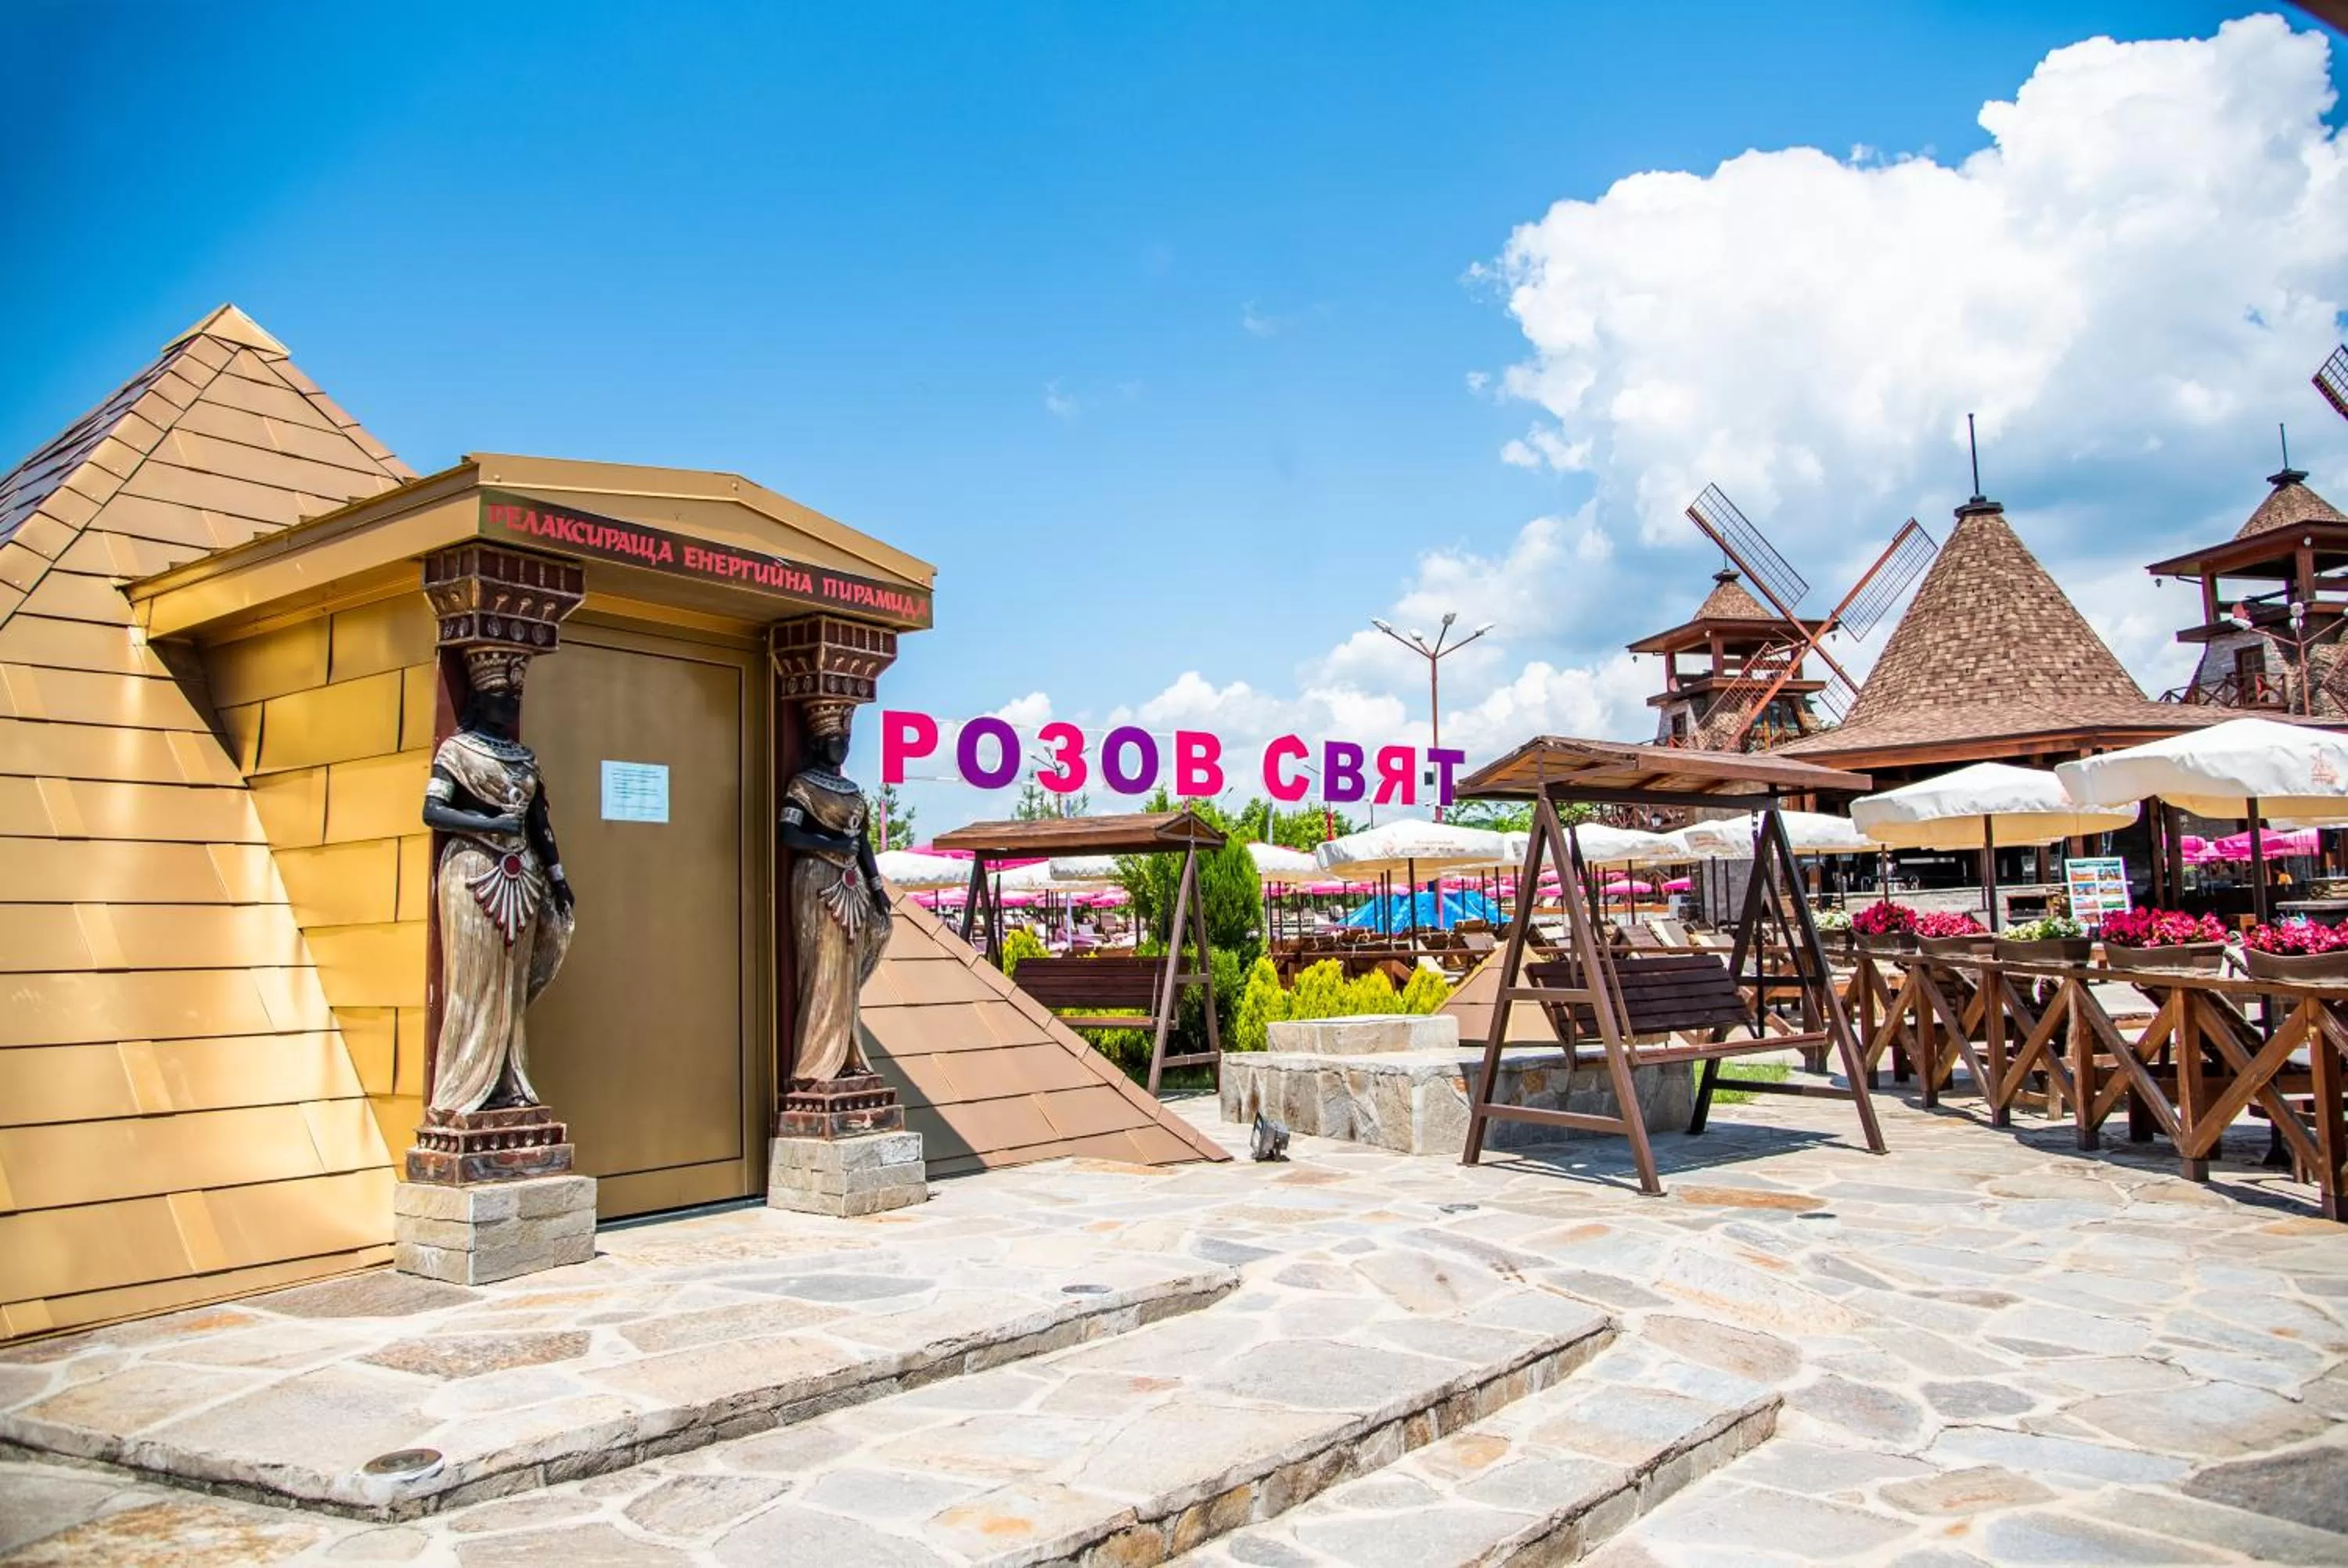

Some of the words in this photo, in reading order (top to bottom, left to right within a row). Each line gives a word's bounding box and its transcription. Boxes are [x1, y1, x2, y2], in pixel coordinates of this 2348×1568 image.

[488, 502, 674, 566] РЕЛАКСИРАЩА
[683, 545, 813, 595] ЕНЕРГИЙНА
[823, 577, 928, 620] ПИРАМИДА
[880, 709, 1224, 797] РОЗОВ
[1262, 733, 1466, 807] СВЯТ
